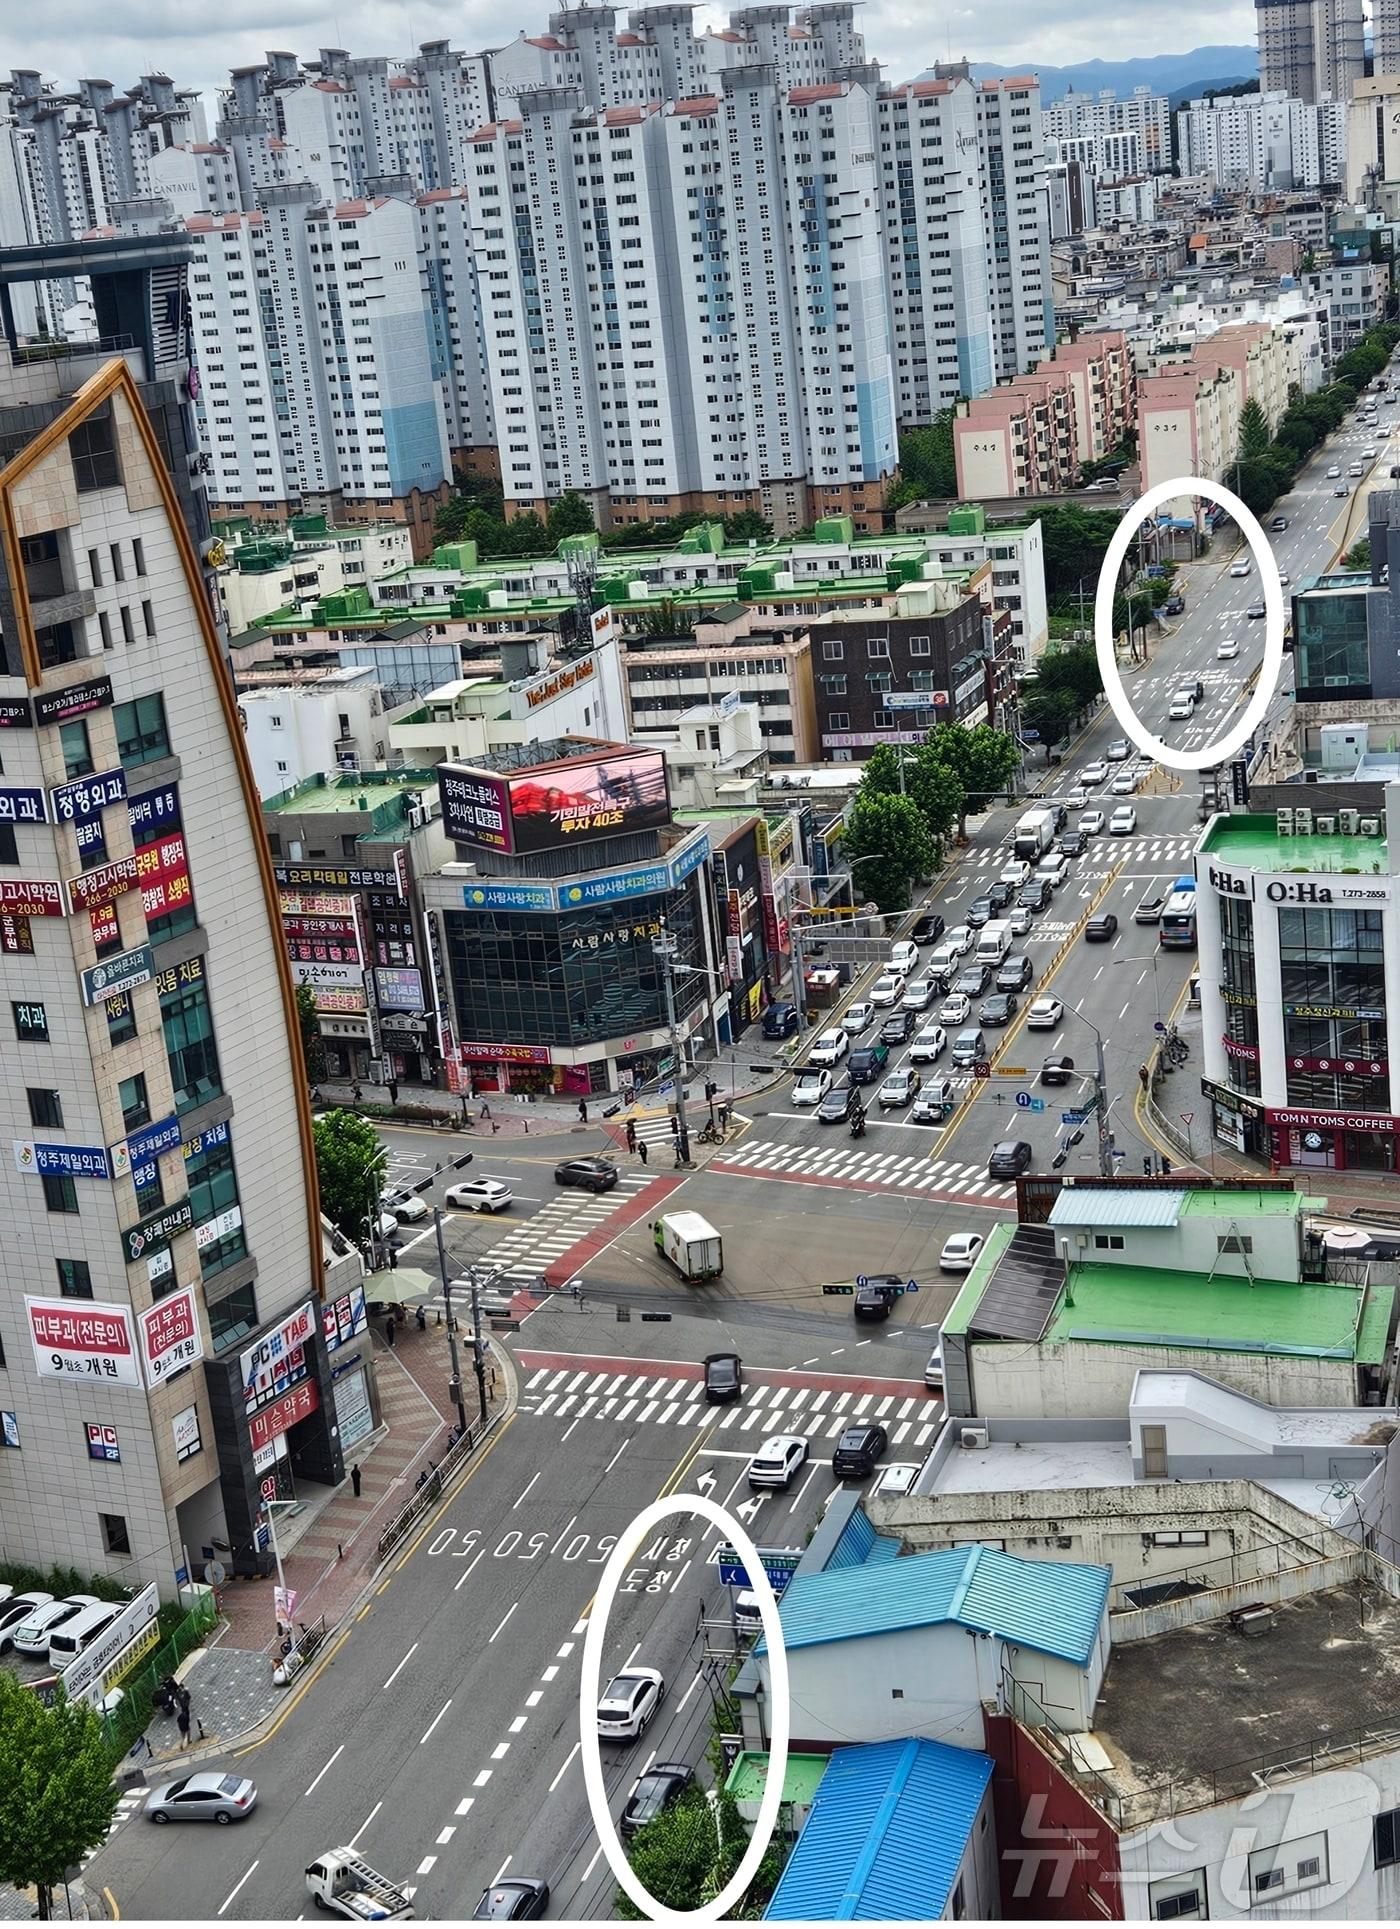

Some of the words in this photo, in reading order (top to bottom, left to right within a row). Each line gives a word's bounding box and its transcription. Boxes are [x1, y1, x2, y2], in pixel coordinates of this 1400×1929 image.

[153, 182, 197, 195] CANTAVIL
[575, 657, 594, 682] Hotel
[0, 797, 37, 821] 외과
[59, 778, 122, 819] 정형외과
[550, 796, 631, 823] 기회발전특구
[561, 816, 591, 833] 투자
[592, 810, 625, 827] 40조
[161, 841, 184, 867] 행정직
[76, 858, 137, 897] 행정고시학원
[349, 871, 397, 886] 전문학원
[584, 871, 666, 897] 사람사랑치과의원
[0, 881, 59, 903] 고시학원
[487, 892, 545, 904] 사람사랑치과
[1266, 882, 1334, 903] O:Ha
[93, 921, 118, 942] 공무원
[572, 922, 661, 949] 사람사랑치과
[106, 952, 145, 978] 올바른치과
[155, 968, 177, 996] 잇몸
[179, 958, 202, 983] 치료
[18, 1005, 45, 1028] 치과
[1231, 1046, 1256, 1059] TOMS
[1272, 1112, 1299, 1123] TOM
[1310, 1115, 1345, 1126] TOMS
[1347, 1118, 1394, 1130] COFFEE
[129, 1125, 179, 1160] 청주제일외과
[205, 1123, 227, 1145] 치질
[37, 1150, 105, 1171] 청주제일외과
[134, 1161, 156, 1186] 맹장
[148, 1300, 188, 1335] 피부과
[33, 1315, 126, 1347] 피부과(전문의)
[153, 1319, 189, 1352] (전문의)
[173, 1339, 195, 1360] 개원
[251, 1343, 270, 1370] PC
[84, 1358, 119, 1378] 개원
[89, 1424, 116, 1444] PC
[106, 1449, 119, 1459] 2F
[427, 1528, 482, 1556] 50
[493, 1530, 550, 1559] 50
[562, 1533, 617, 1563] 50
[641, 1537, 693, 1562] 시청
[618, 1567, 672, 1594] 도청
